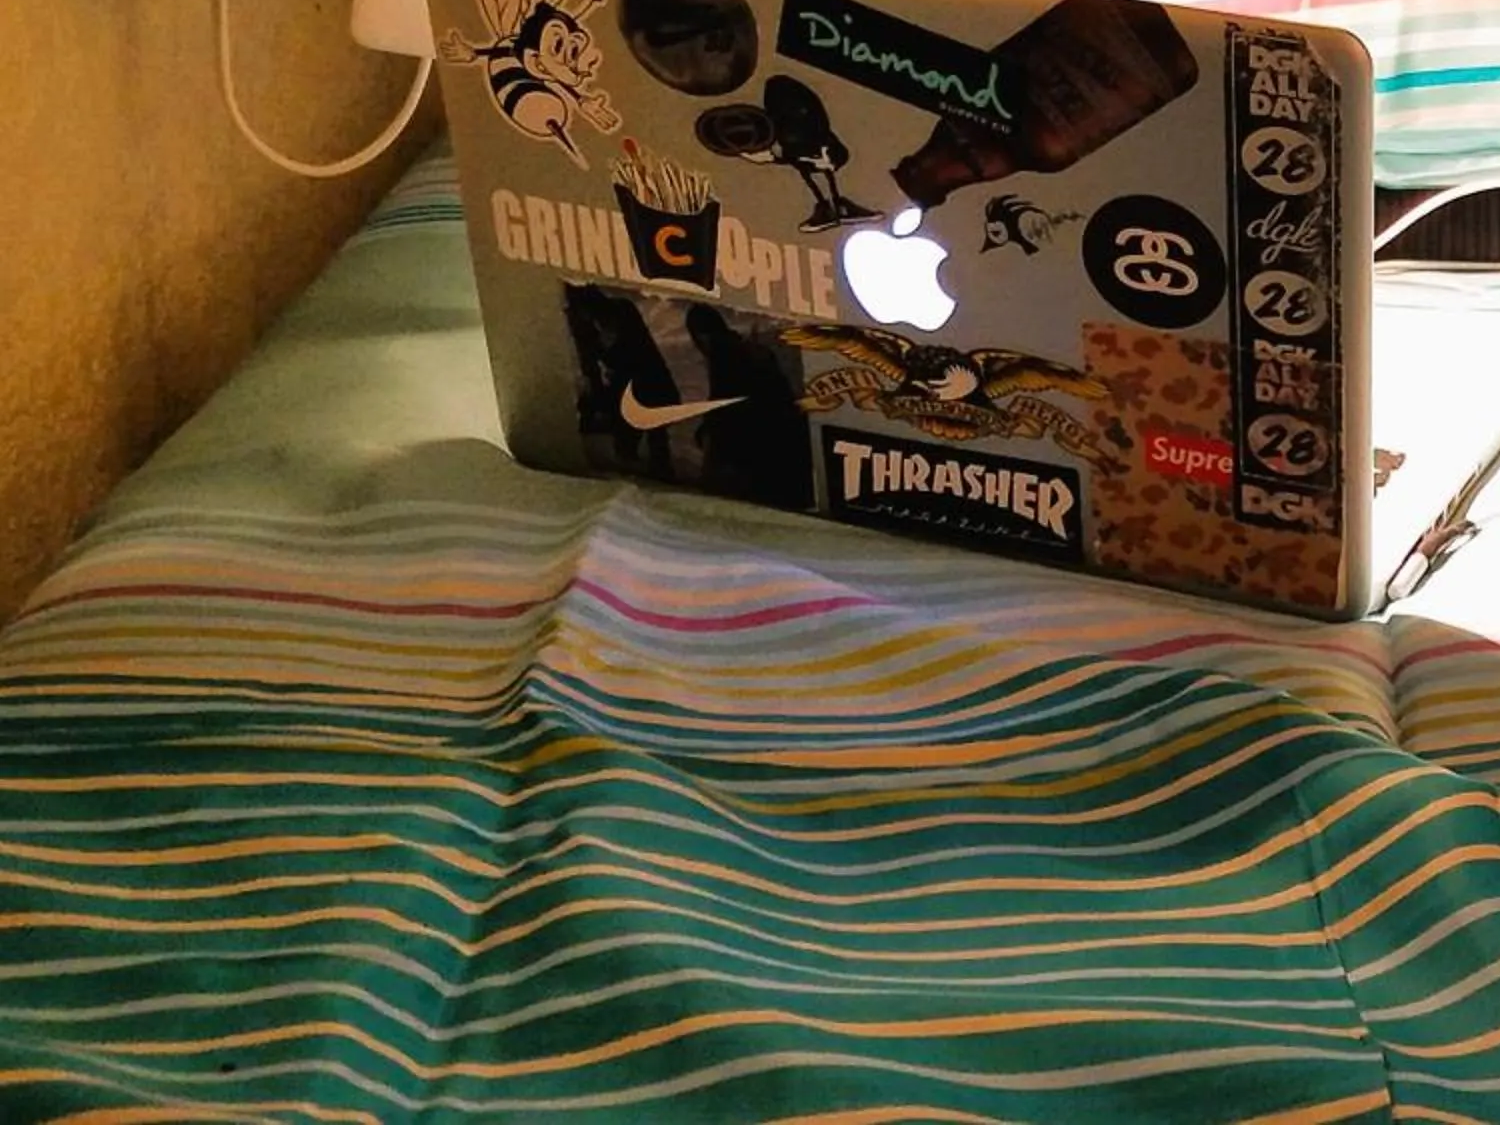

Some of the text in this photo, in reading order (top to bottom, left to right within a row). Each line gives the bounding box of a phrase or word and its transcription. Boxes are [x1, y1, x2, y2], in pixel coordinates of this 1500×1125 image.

[799, 11, 1013, 119] Diamond
[1251, 71, 1313, 99] ALL
[1250, 92, 1314, 123] DAY
[1253, 138, 1315, 184] 28
[655, 226, 693, 266] C
[1246, 199, 1323, 264] dgk
[715, 216, 838, 320] OPLE
[1254, 283, 1315, 325] 28
[1151, 436, 1233, 474] Supre
[1258, 425, 1316, 465] 28
[834, 440, 1075, 540] THRASHER
